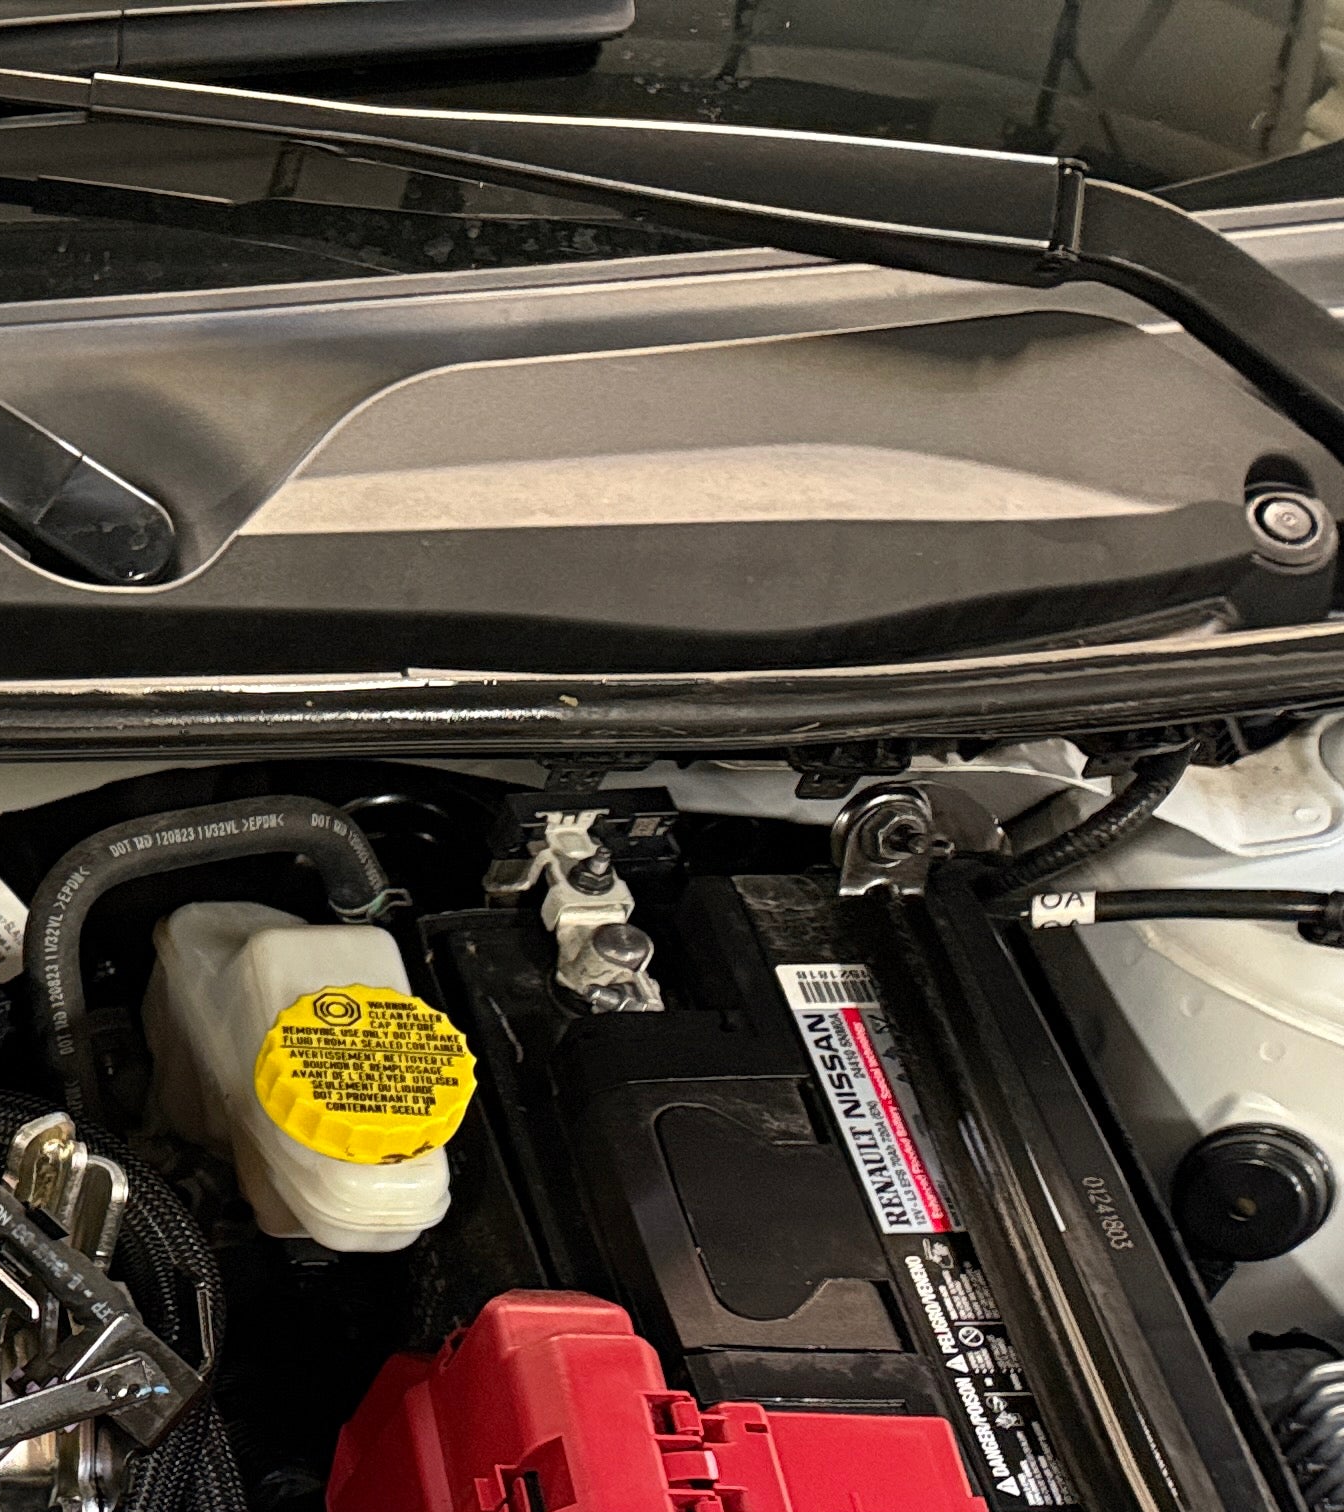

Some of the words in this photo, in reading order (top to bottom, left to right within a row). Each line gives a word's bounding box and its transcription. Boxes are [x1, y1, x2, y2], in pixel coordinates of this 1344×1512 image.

[110, 839, 132, 858] DOT
[156, 827, 194, 846] 120823
[370, 1021, 391, 1029] CAP
[397, 1023, 435, 1032] BEFORE
[283, 1036, 312, 1045] FLUID
[317, 1037, 347, 1047] FROM
[362, 1040, 401, 1050] SEALED
[341, 1029, 358, 1037] USE
[393, 1032, 413, 1040] DOT
[426, 1034, 460, 1043] BRAKE
[303, 1060, 350, 1070] BOUCHON
[353, 1062, 365, 1070] DE
[801, 1012, 865, 1117] NISSAN
[292, 1070, 328, 1080] AVANT
[332, 1072, 345, 1081] DE
[312, 1081, 374, 1091] SEULEMENT
[313, 1091, 333, 1100] DOT
[346, 1092, 408, 1103] PROVENANT
[326, 1102, 387, 1114] CONTENANT
[849, 1127, 912, 1227] RENAULT
[905, 1255, 959, 1354] PELIGRO/VENENO
[955, 1377, 1010, 1477] DANGER/POISON
